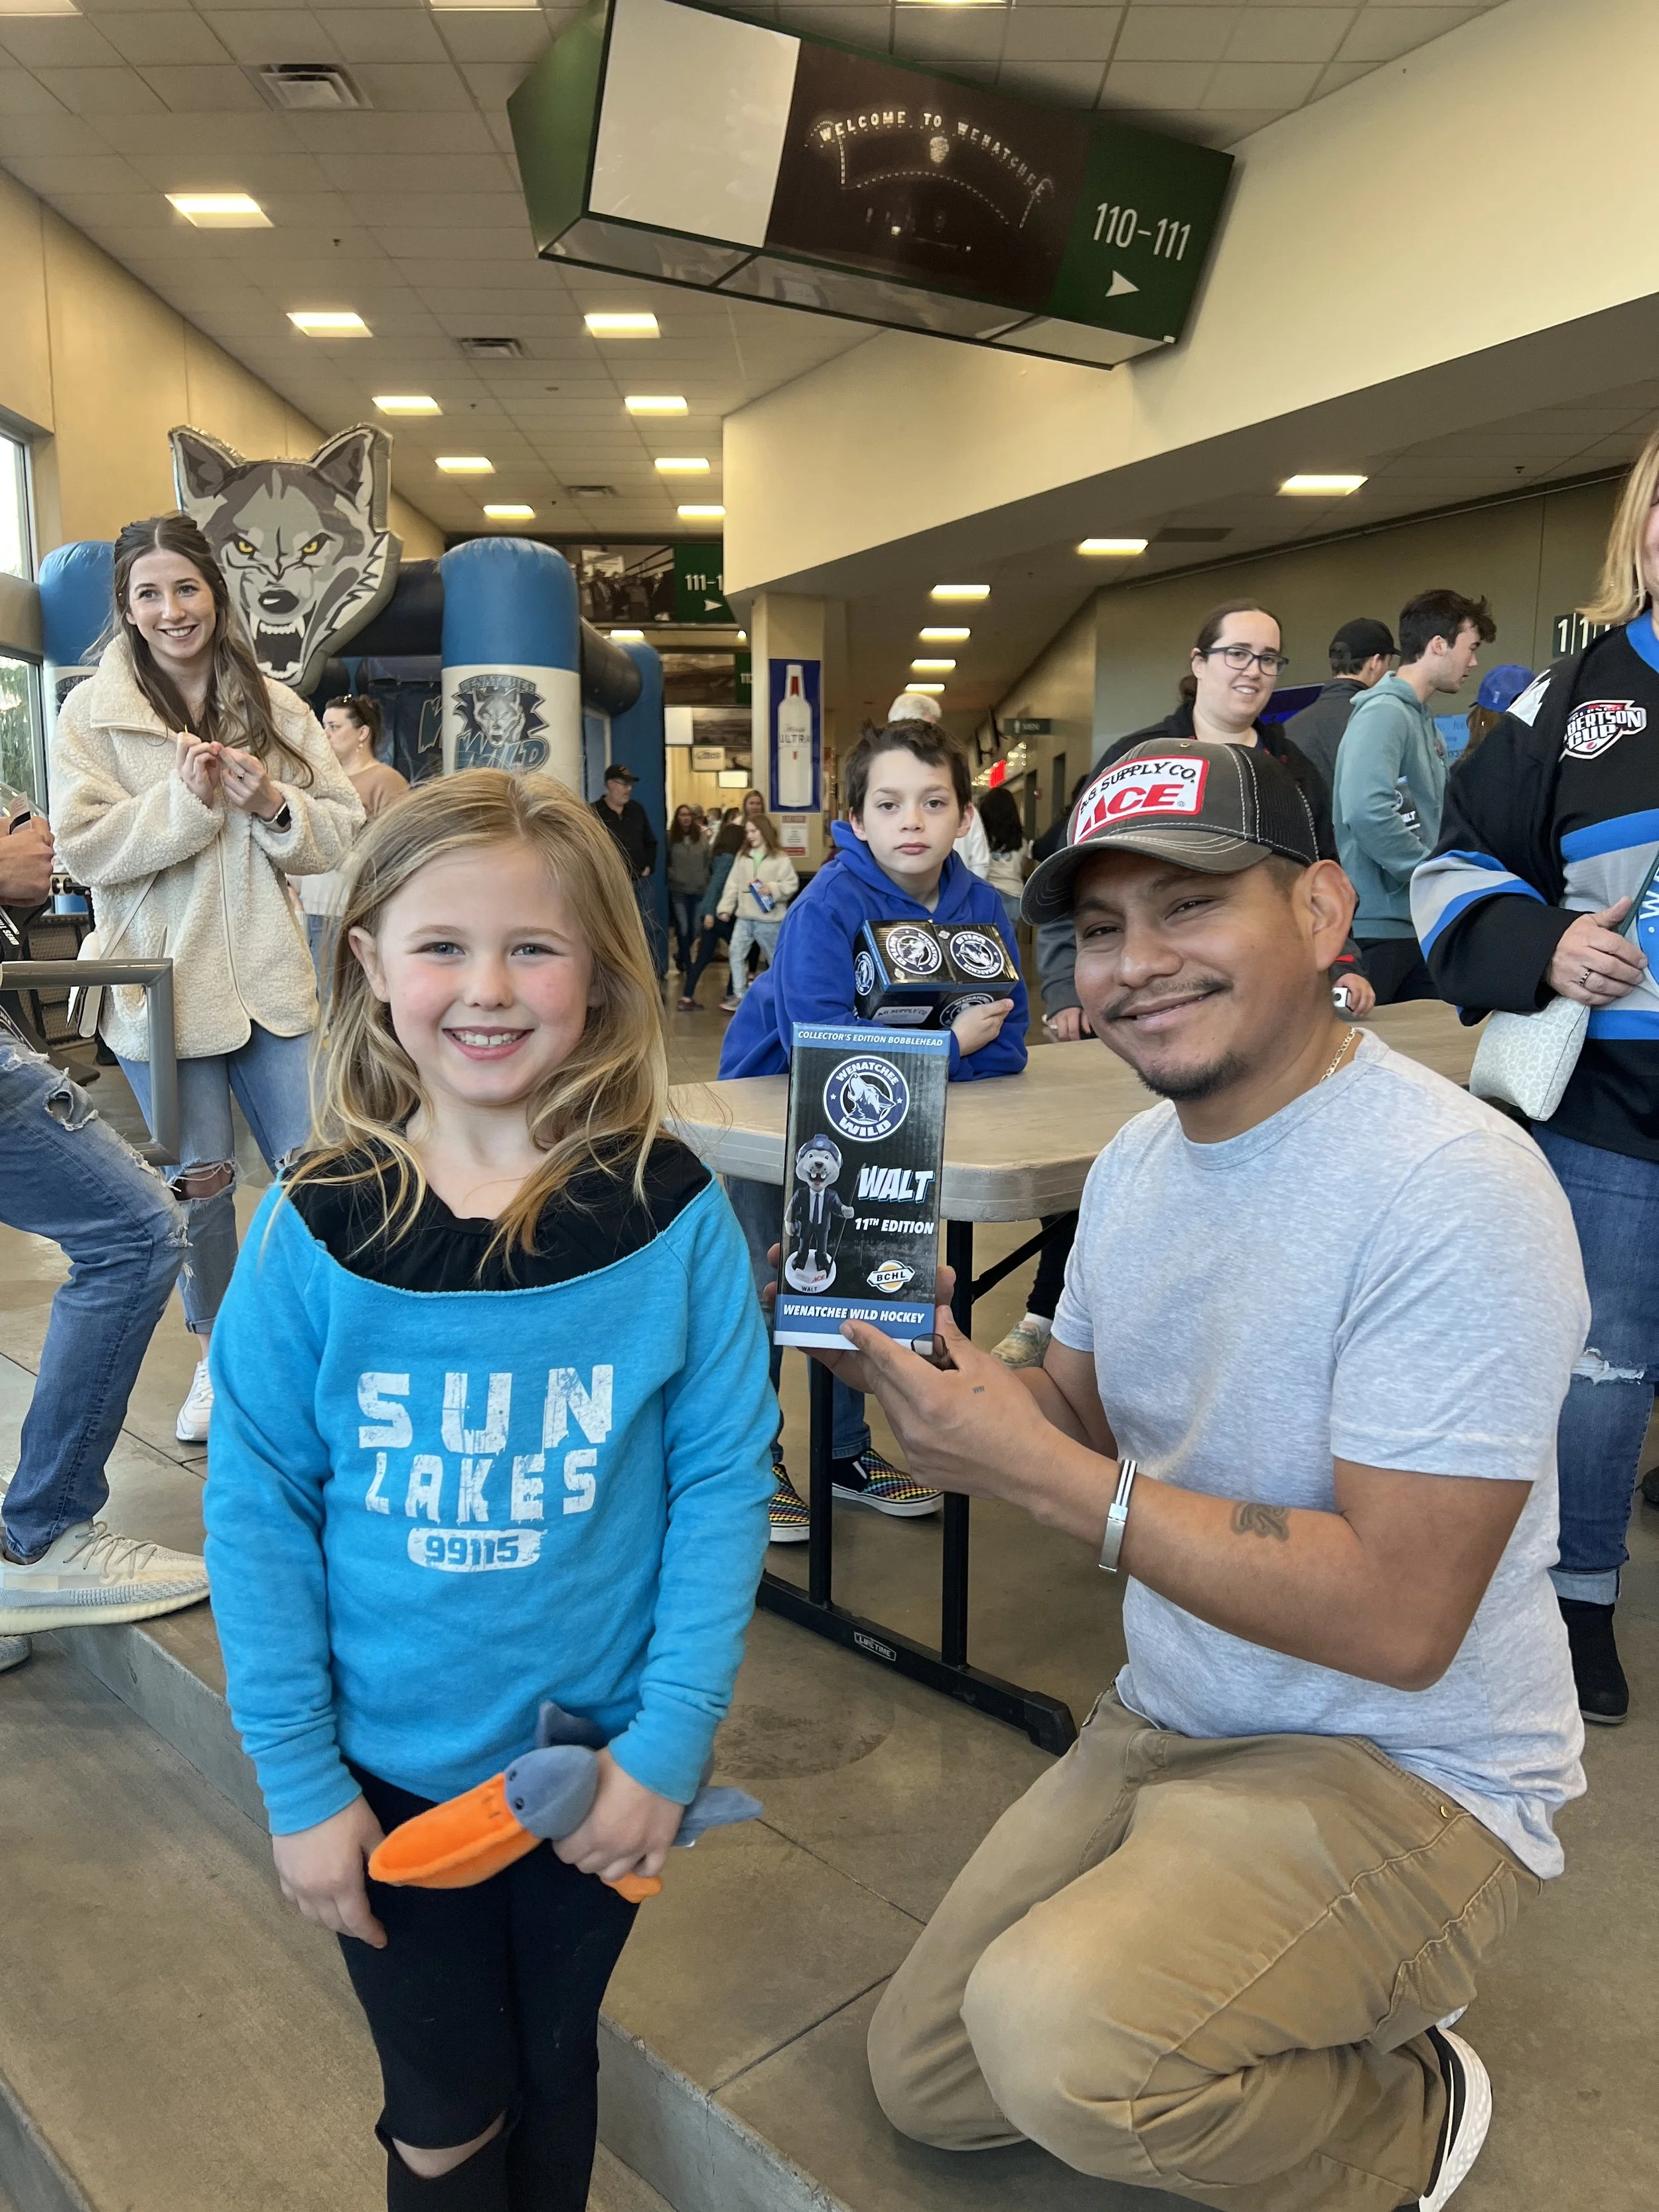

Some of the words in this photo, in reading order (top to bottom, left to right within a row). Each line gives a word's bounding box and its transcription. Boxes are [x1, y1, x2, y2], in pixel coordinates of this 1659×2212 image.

[820, 111, 906, 141] WELCOME
[924, 112, 942, 127] TO
[1094, 202, 1191, 261] 110-111
[1565, 711, 1642, 736] BERTSON
[1568, 724, 1617, 750] CUP
[1100, 762, 1172, 792] SUPPLY
[1079, 784, 1185, 837] ACE
[956, 934, 986, 945] WILD
[798, 1031, 851, 1041] COLLECTOR'S
[853, 1034, 886, 1043] EDITION
[888, 1036, 943, 1047] BOBBLEHEAD
[835, 1062, 899, 1086] WENATCHEE
[839, 1116, 892, 1136] WILD
[857, 1165, 934, 1203] WALT
[855, 1218, 879, 1230] 11TH
[881, 1220, 934, 1234] EDITION
[877, 1272, 906, 1282] BCHL
[783, 1304, 847, 1319] WENATCHEE
[849, 1308, 878, 1321] WILD
[880, 1310, 924, 1324] HOCKEY
[358, 1364, 613, 1455] SUN
[366, 1448, 597, 1524] LAKES
[425, 1536, 519, 1566] 99115
[859, 1635, 892, 1657] LIFETIME
